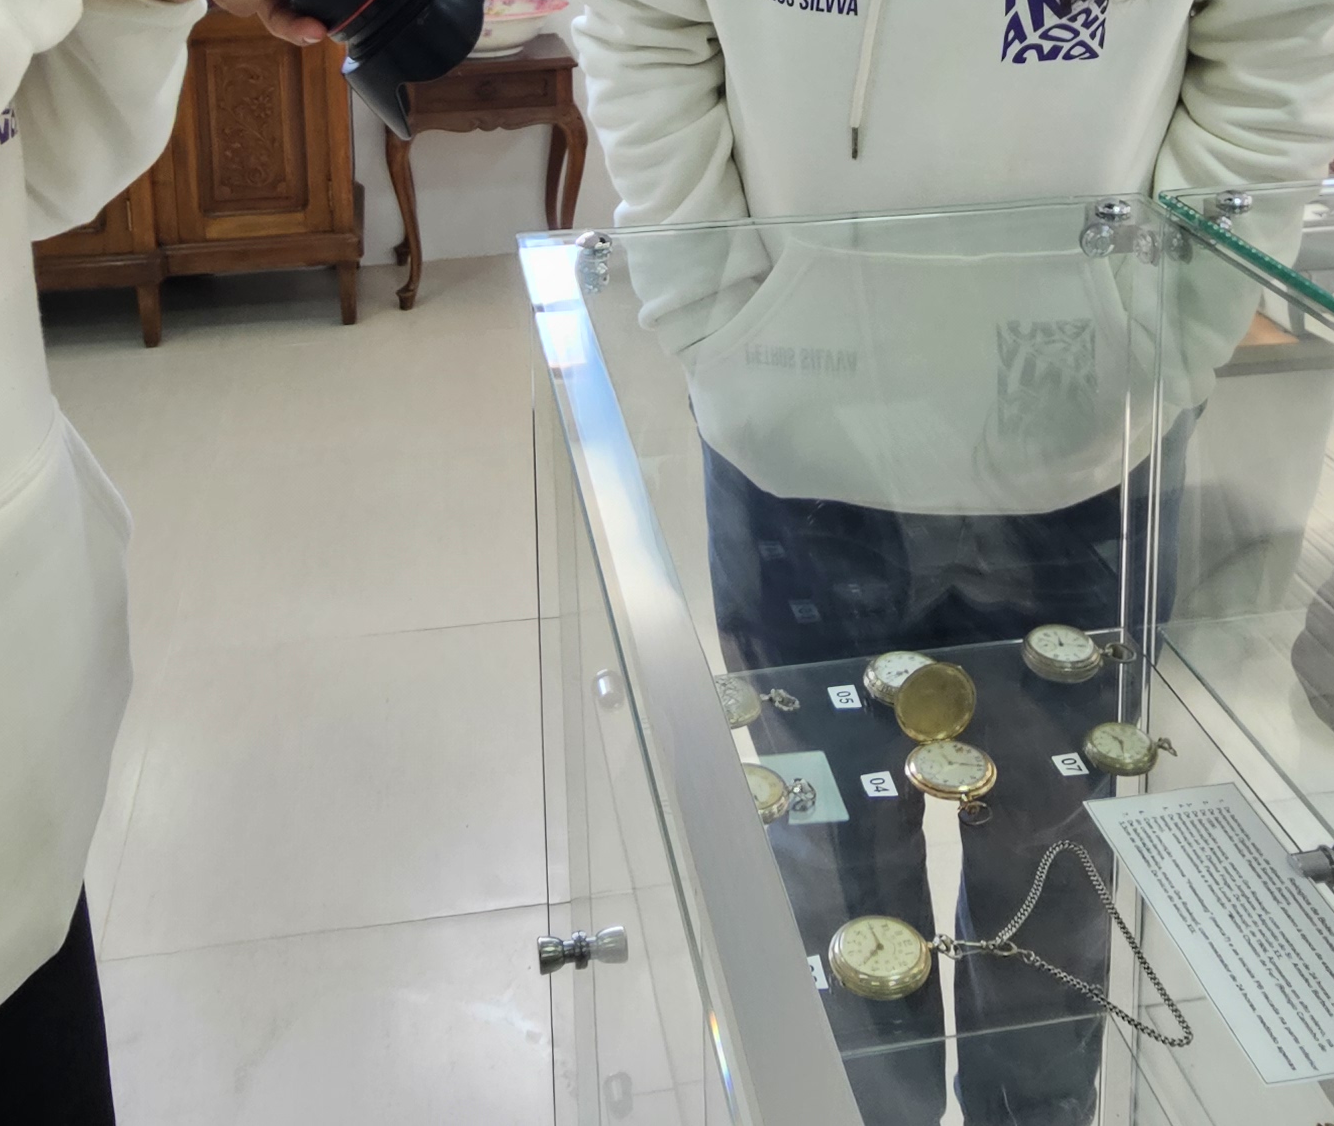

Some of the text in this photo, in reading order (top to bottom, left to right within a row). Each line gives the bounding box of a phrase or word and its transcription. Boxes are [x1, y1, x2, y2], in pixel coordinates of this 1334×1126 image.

[835, 689, 855, 705] 05
[1060, 756, 1084, 773] 07
[869, 776, 890, 794] 04
